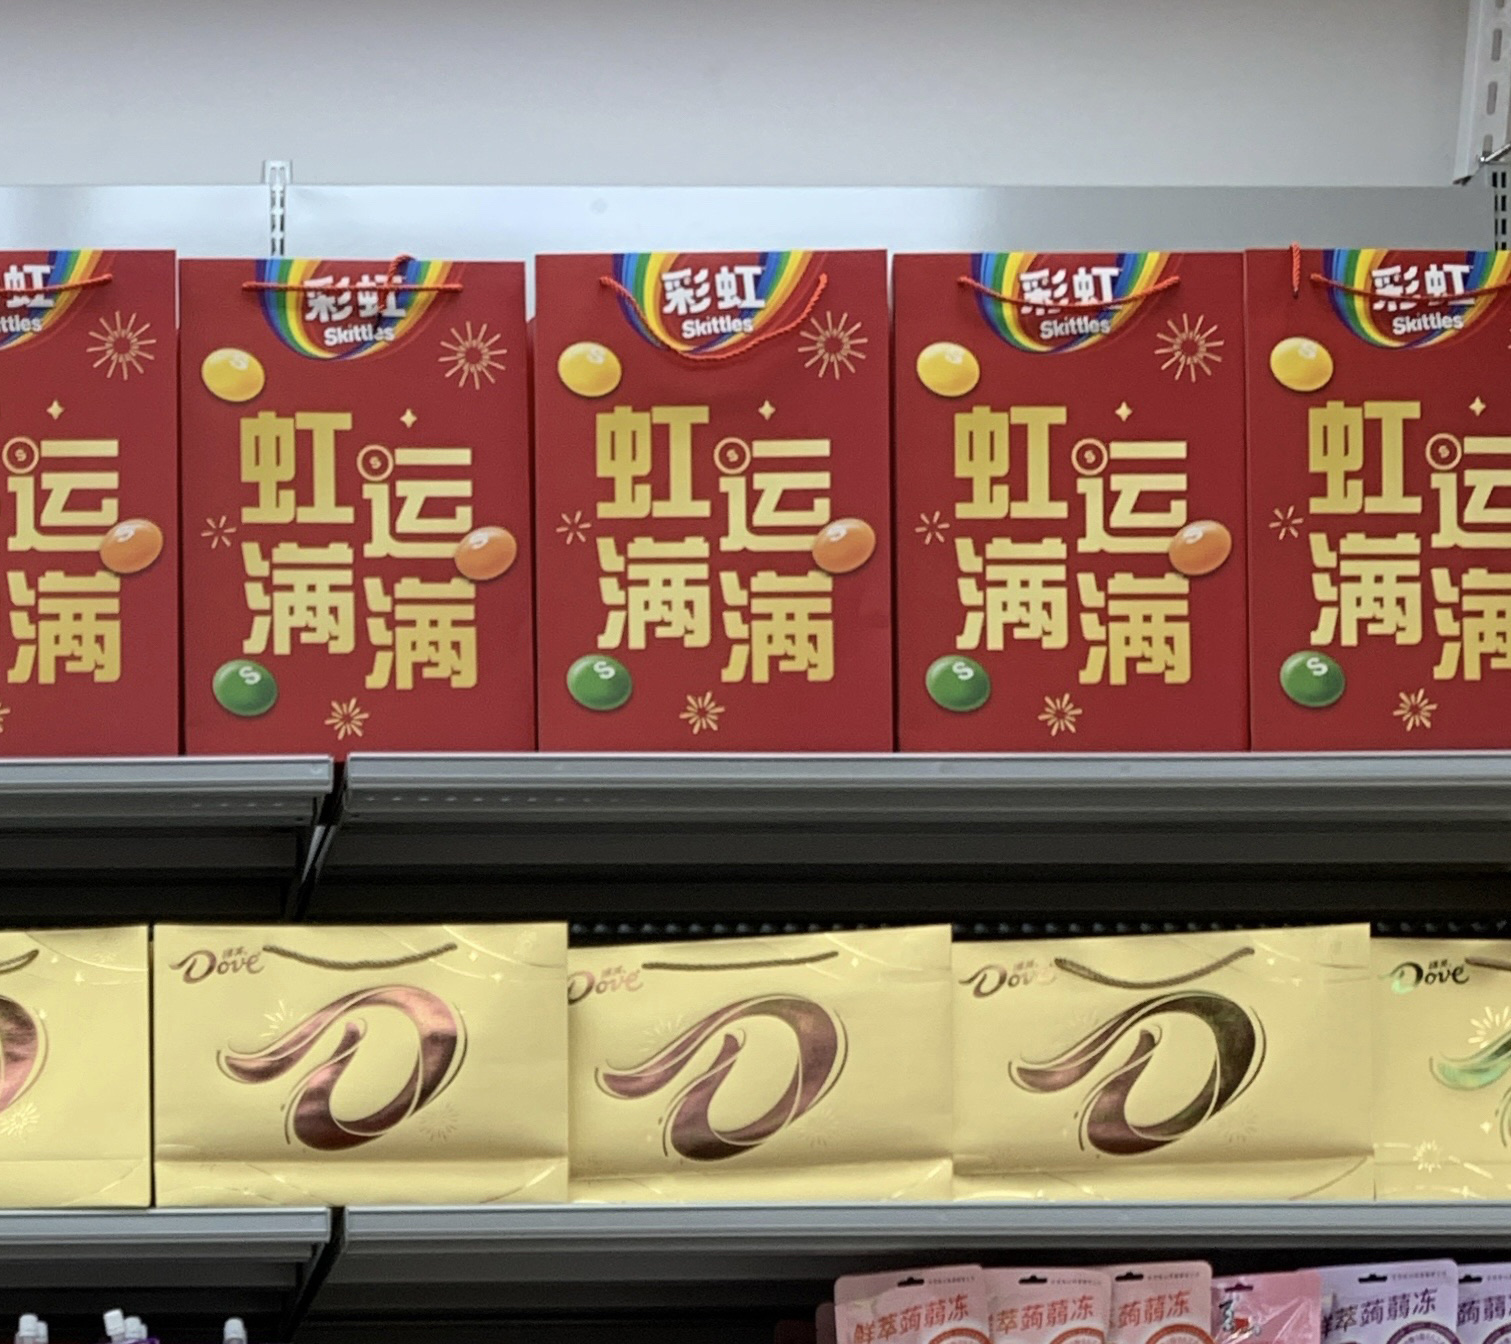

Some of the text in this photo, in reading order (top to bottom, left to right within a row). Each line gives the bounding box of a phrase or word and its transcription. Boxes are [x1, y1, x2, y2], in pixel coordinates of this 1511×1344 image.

[305, 273, 406, 323] 彩虹
[661, 265, 765, 315] 彩虹
[1020, 265, 1123, 316] 彩虹
[1372, 262, 1476, 312] 彩虹
[324, 321, 395, 347] Skittles
[682, 313, 753, 339] Skittles
[1039, 315, 1111, 340] Skittles
[1392, 310, 1464, 336] Skittles
[169, 949, 265, 984] Dove
